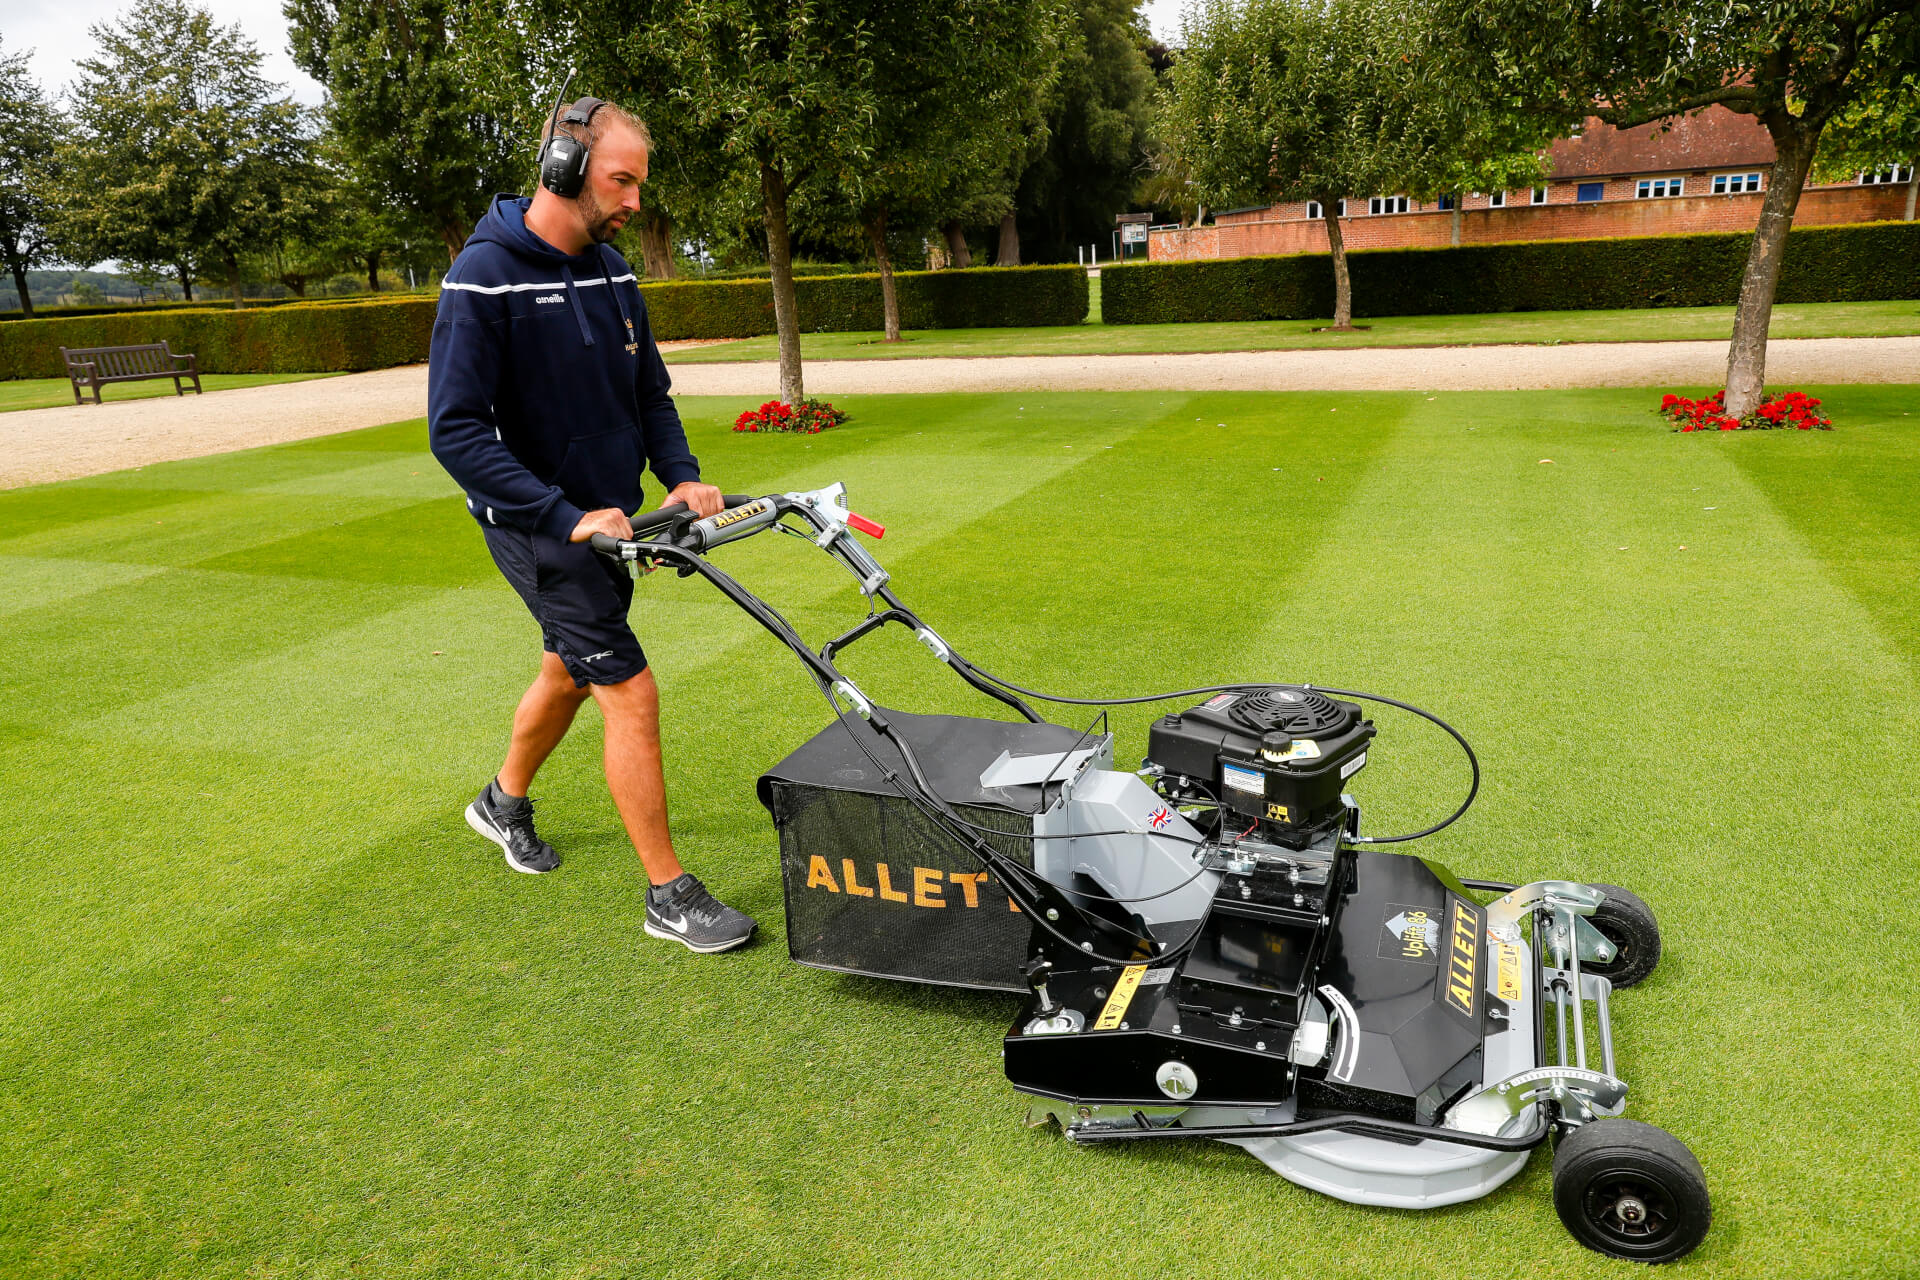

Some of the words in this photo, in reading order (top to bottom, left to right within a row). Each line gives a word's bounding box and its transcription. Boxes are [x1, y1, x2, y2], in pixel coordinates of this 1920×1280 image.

[715, 501, 764, 527] ALLETT
[806, 855, 1023, 912] ALLET
[1407, 911, 1428, 924] 86
[1402, 925, 1430, 958] Uplift
[1450, 905, 1478, 1009] ALLETT
